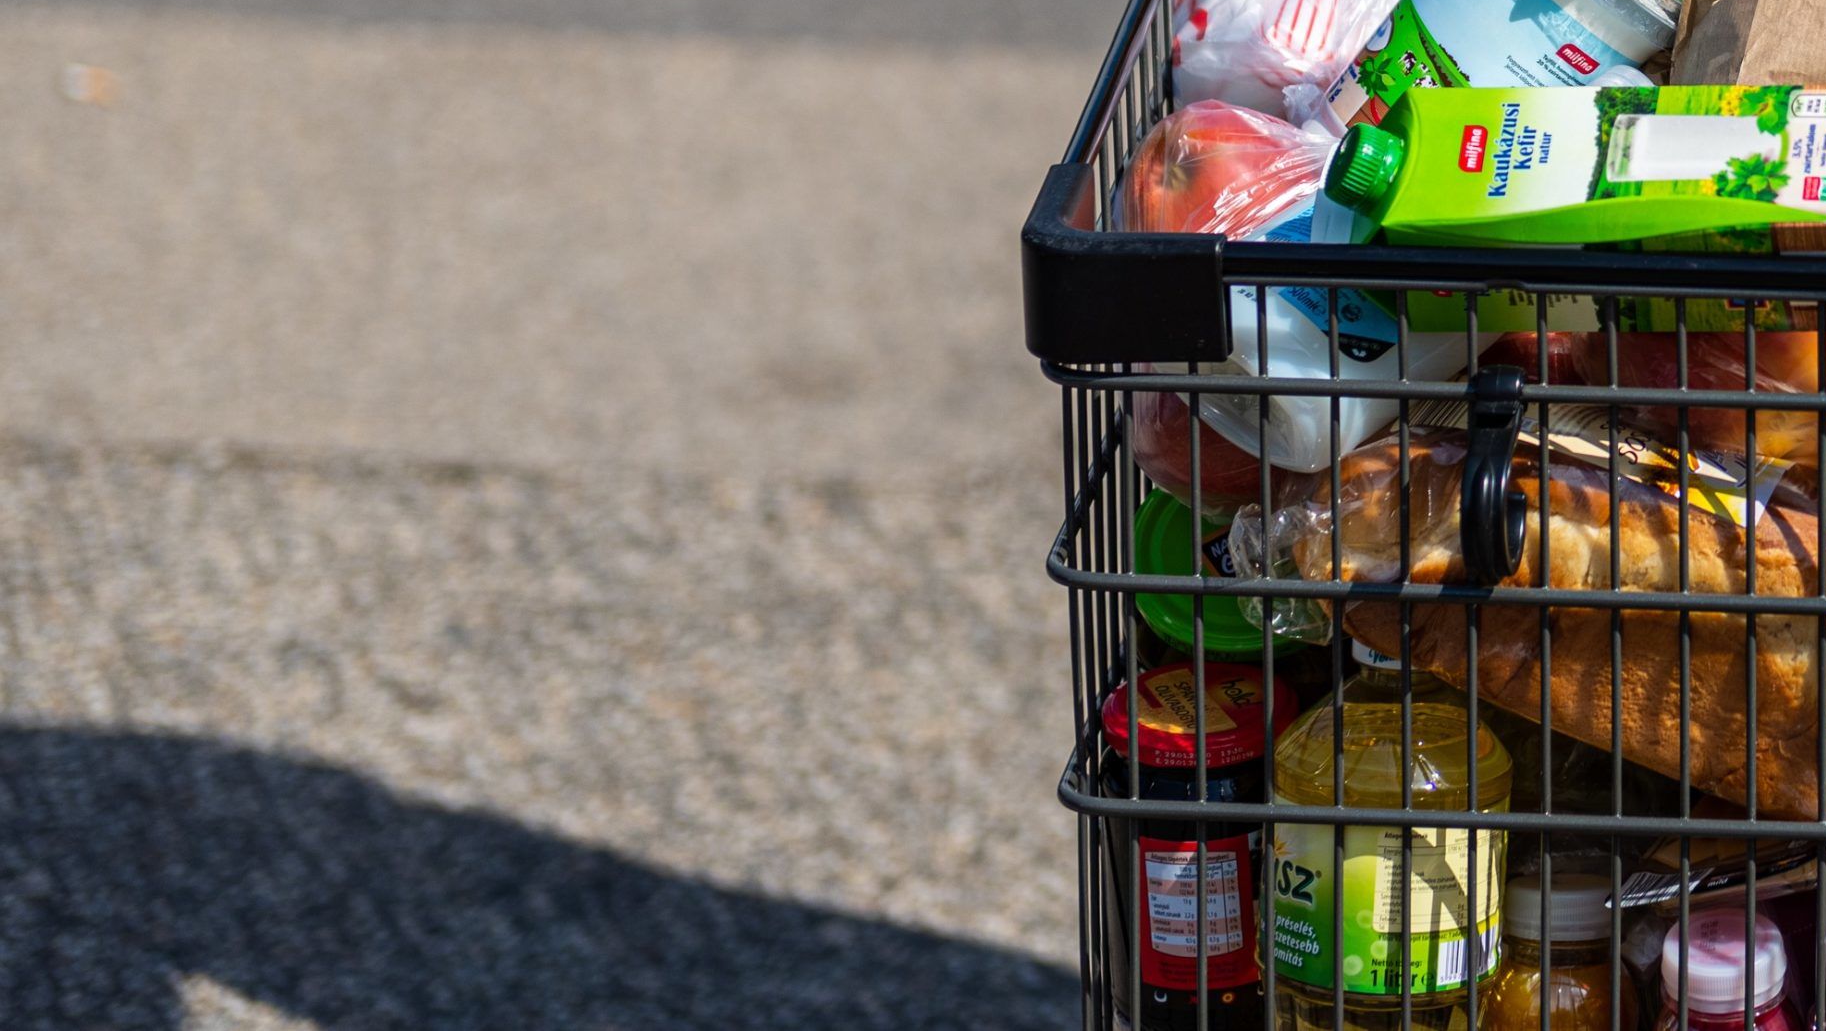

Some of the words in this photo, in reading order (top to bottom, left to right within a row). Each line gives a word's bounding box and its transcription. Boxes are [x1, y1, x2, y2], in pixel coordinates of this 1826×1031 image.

[1561, 45, 1595, 74] milfina
[1465, 128, 1483, 169] milfina
[1488, 103, 1520, 197] Kaukázusi
[1513, 125, 1537, 169] Kefir
[1538, 132, 1552, 164] natur
[1276, 914, 1317, 938] préselés,
[1274, 931, 1320, 955] szetesebb
[1274, 947, 1304, 968] omítás
[1371, 958, 1394, 967] Nettó
[1395, 959, 1422, 969] teg:
[1370, 969, 1378, 987] 1
[1384, 969, 1418, 987] litr
